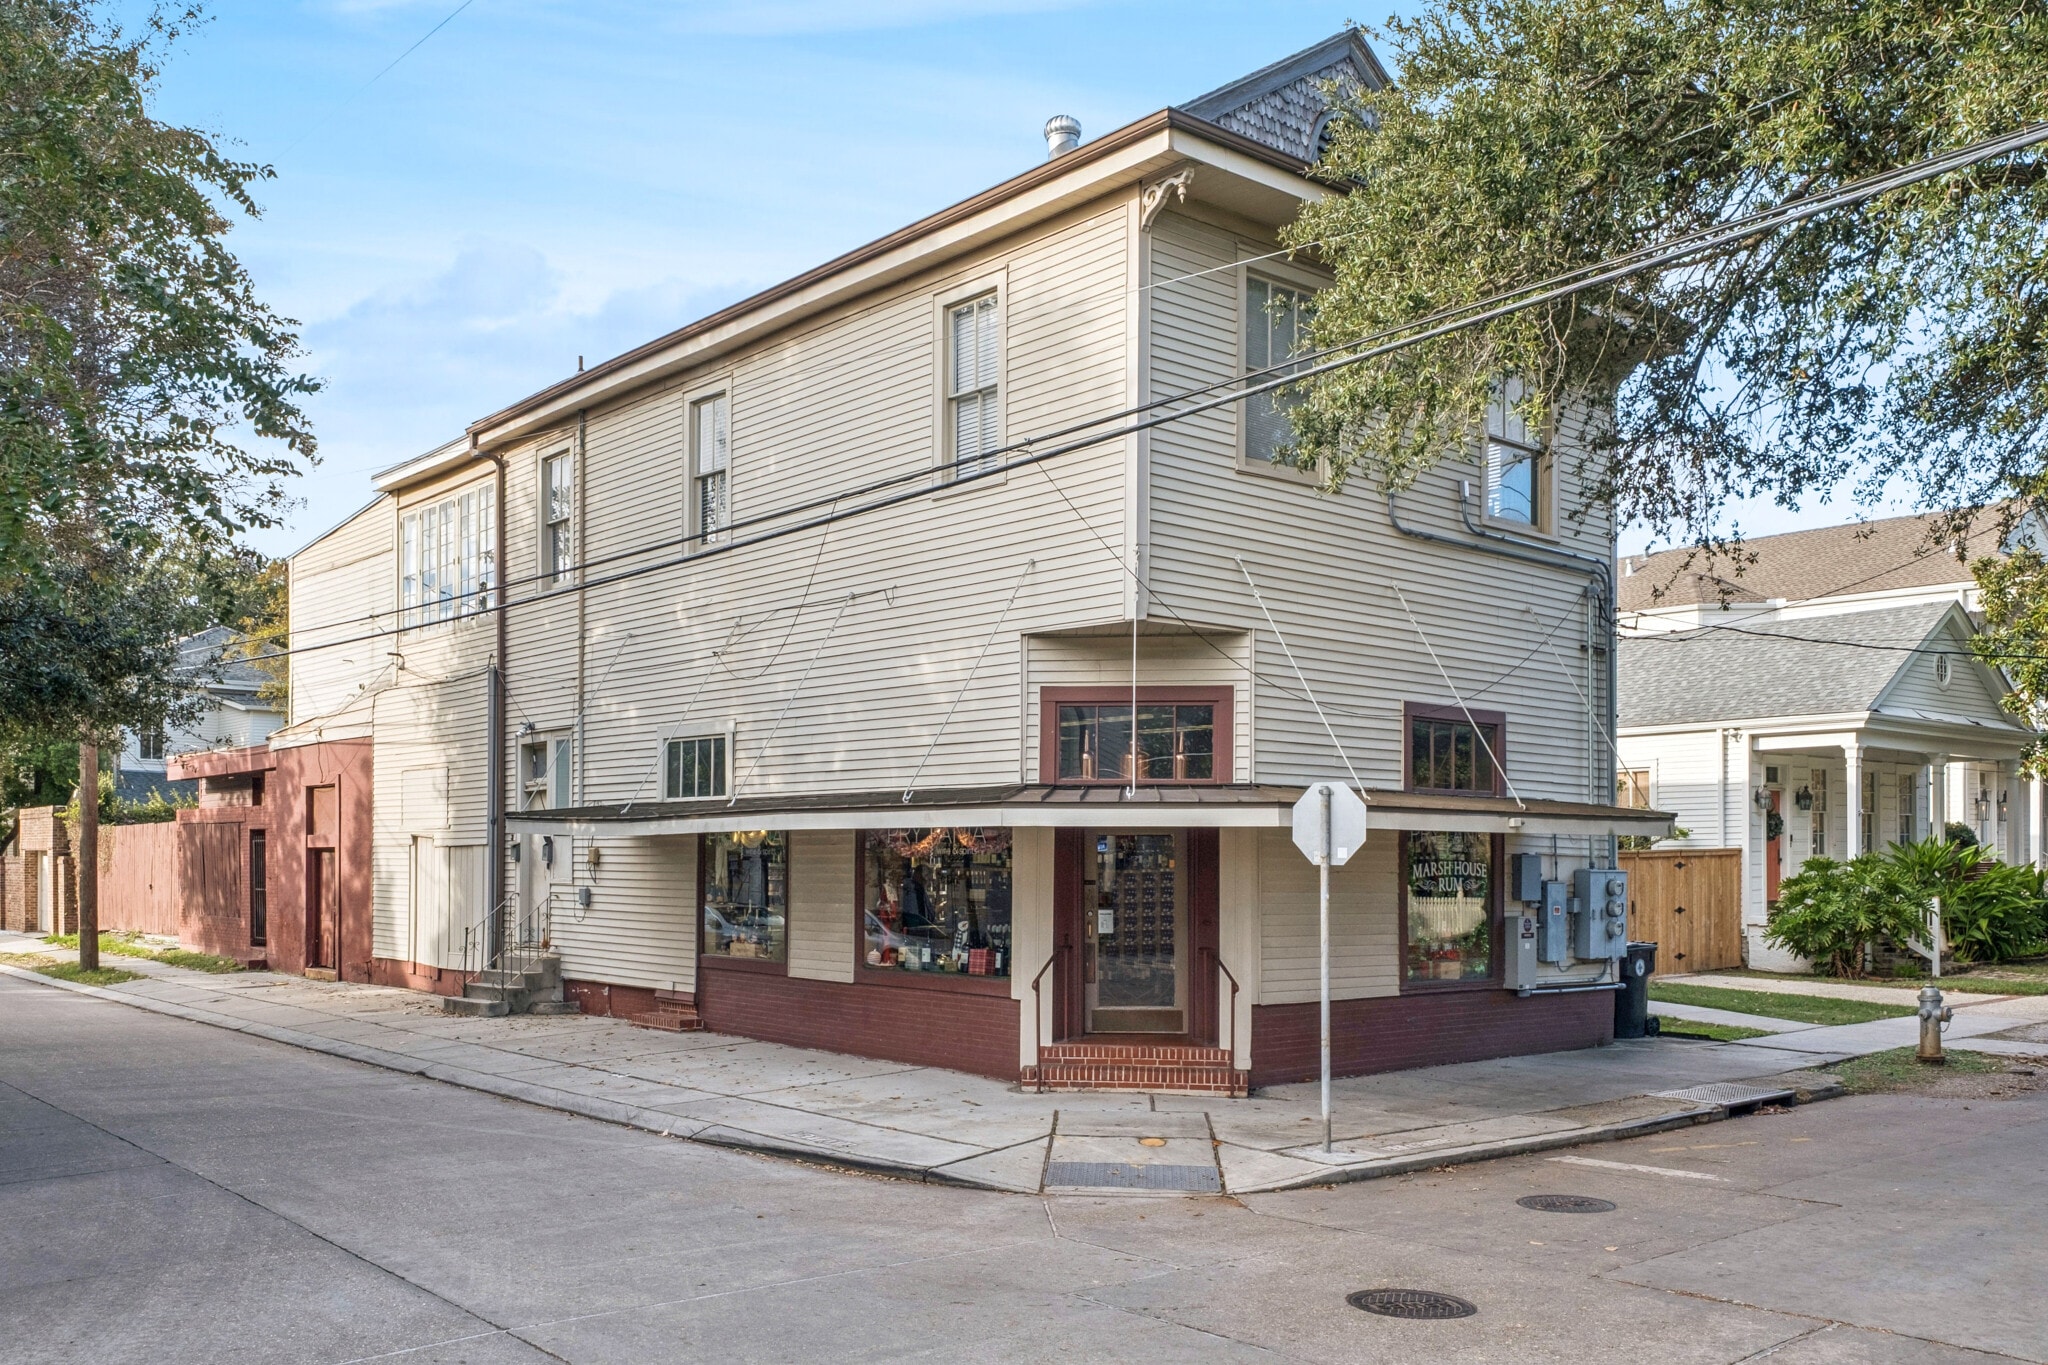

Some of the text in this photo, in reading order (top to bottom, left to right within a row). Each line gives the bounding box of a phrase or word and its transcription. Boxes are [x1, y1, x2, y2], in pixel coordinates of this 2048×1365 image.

[1412, 861, 1487, 879] MARSH HOUSE
[1439, 877, 1464, 892] RUM
